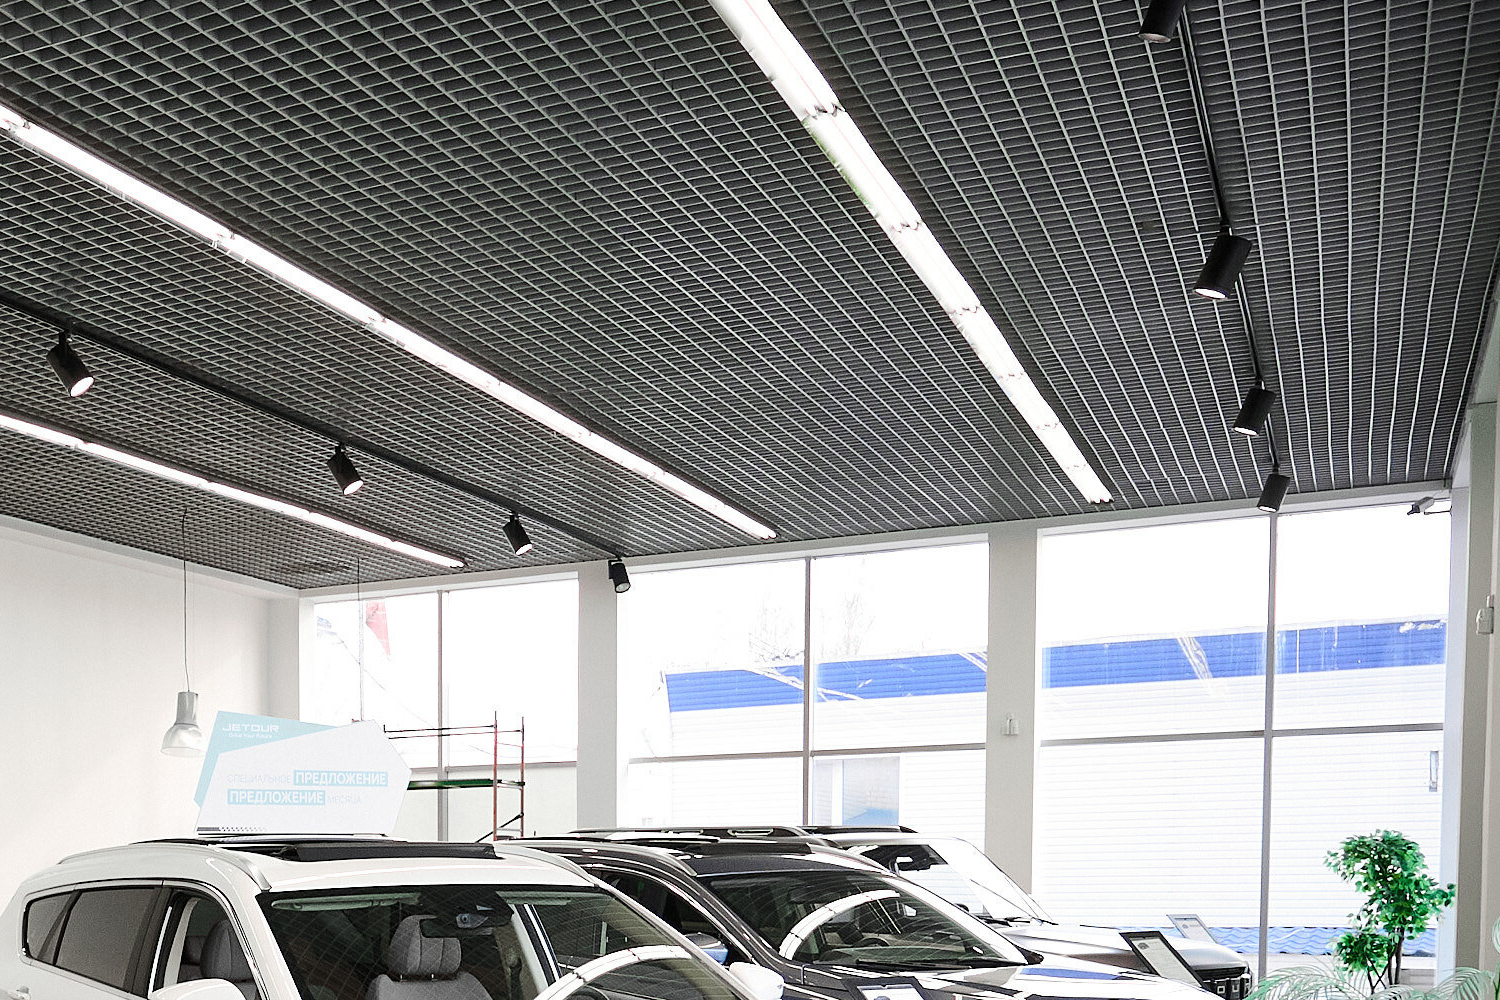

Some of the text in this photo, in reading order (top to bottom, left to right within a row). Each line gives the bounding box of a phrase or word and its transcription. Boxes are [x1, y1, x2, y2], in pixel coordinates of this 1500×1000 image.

[222, 723, 279, 732] JETOUR
[227, 772, 387, 785] СПЕЦИАЛЬНОЕ ПРЕДЛОЖЕНИЕ
[229, 791, 362, 805] ПРЕДЛОЖЕНИЕ МЕСЯЦА
